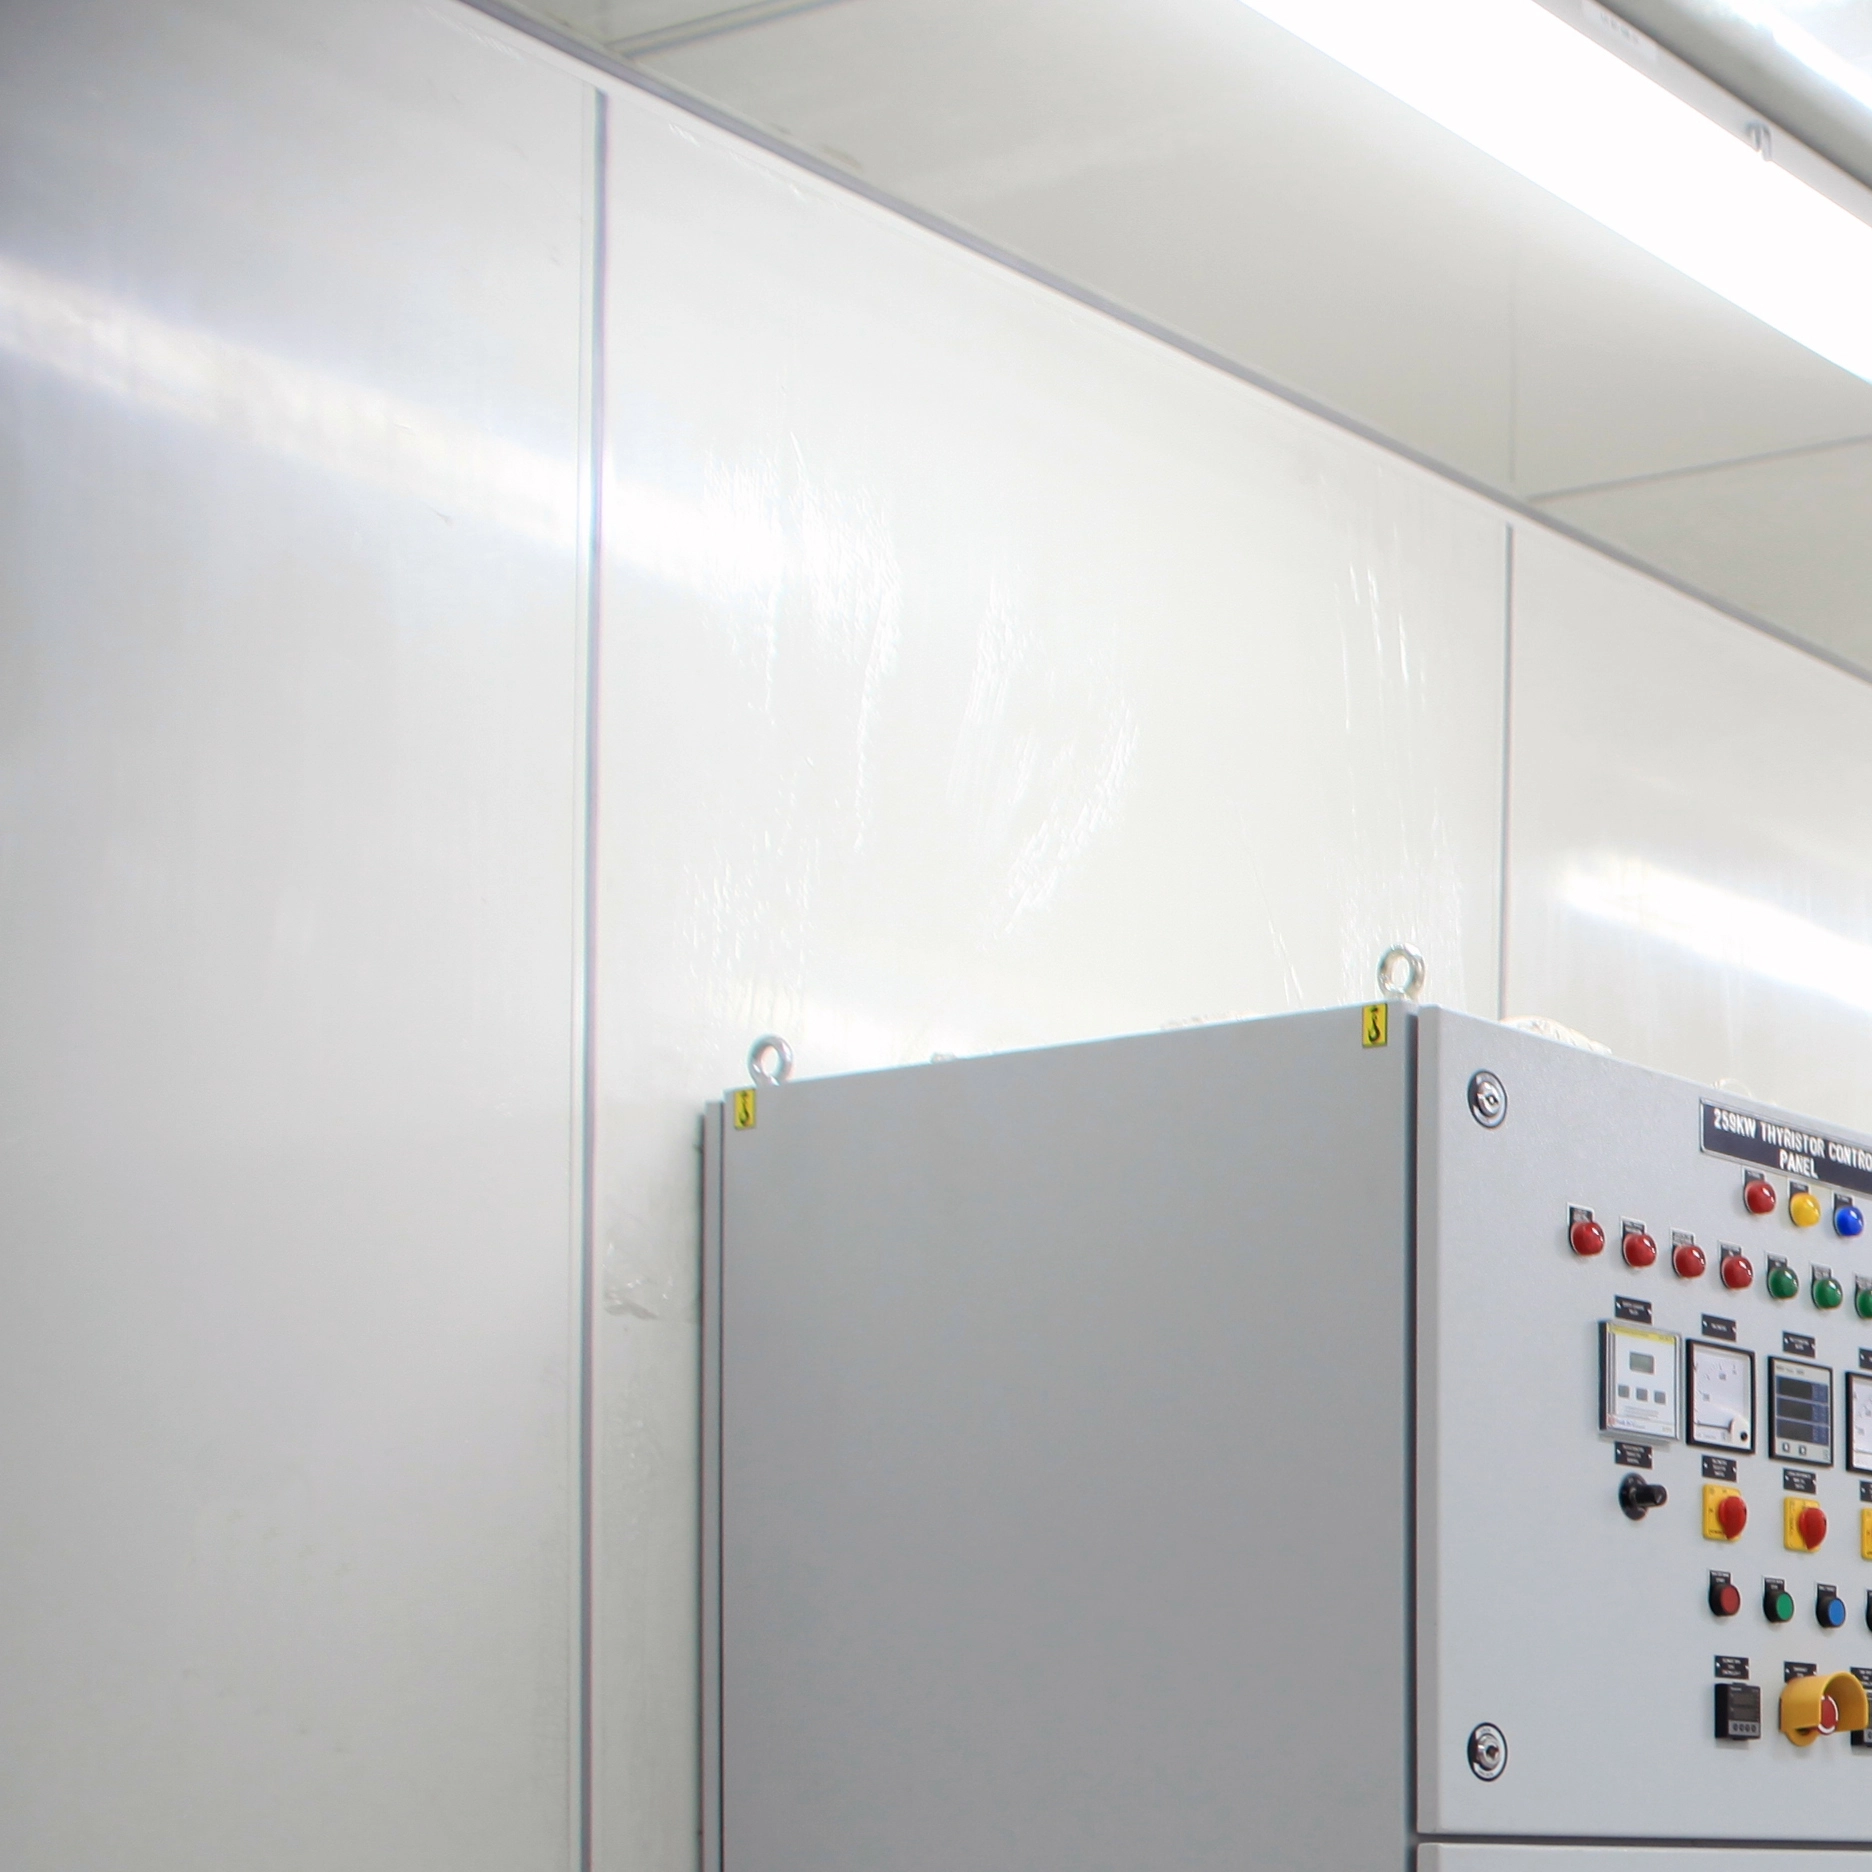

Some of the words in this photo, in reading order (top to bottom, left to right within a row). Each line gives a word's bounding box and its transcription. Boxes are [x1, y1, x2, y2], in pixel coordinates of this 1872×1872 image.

[1713, 1109, 1756, 1140] 259KW
[1760, 1121, 1826, 1160] THYRISTOR
[1779, 1151, 1819, 1180] PANEL
